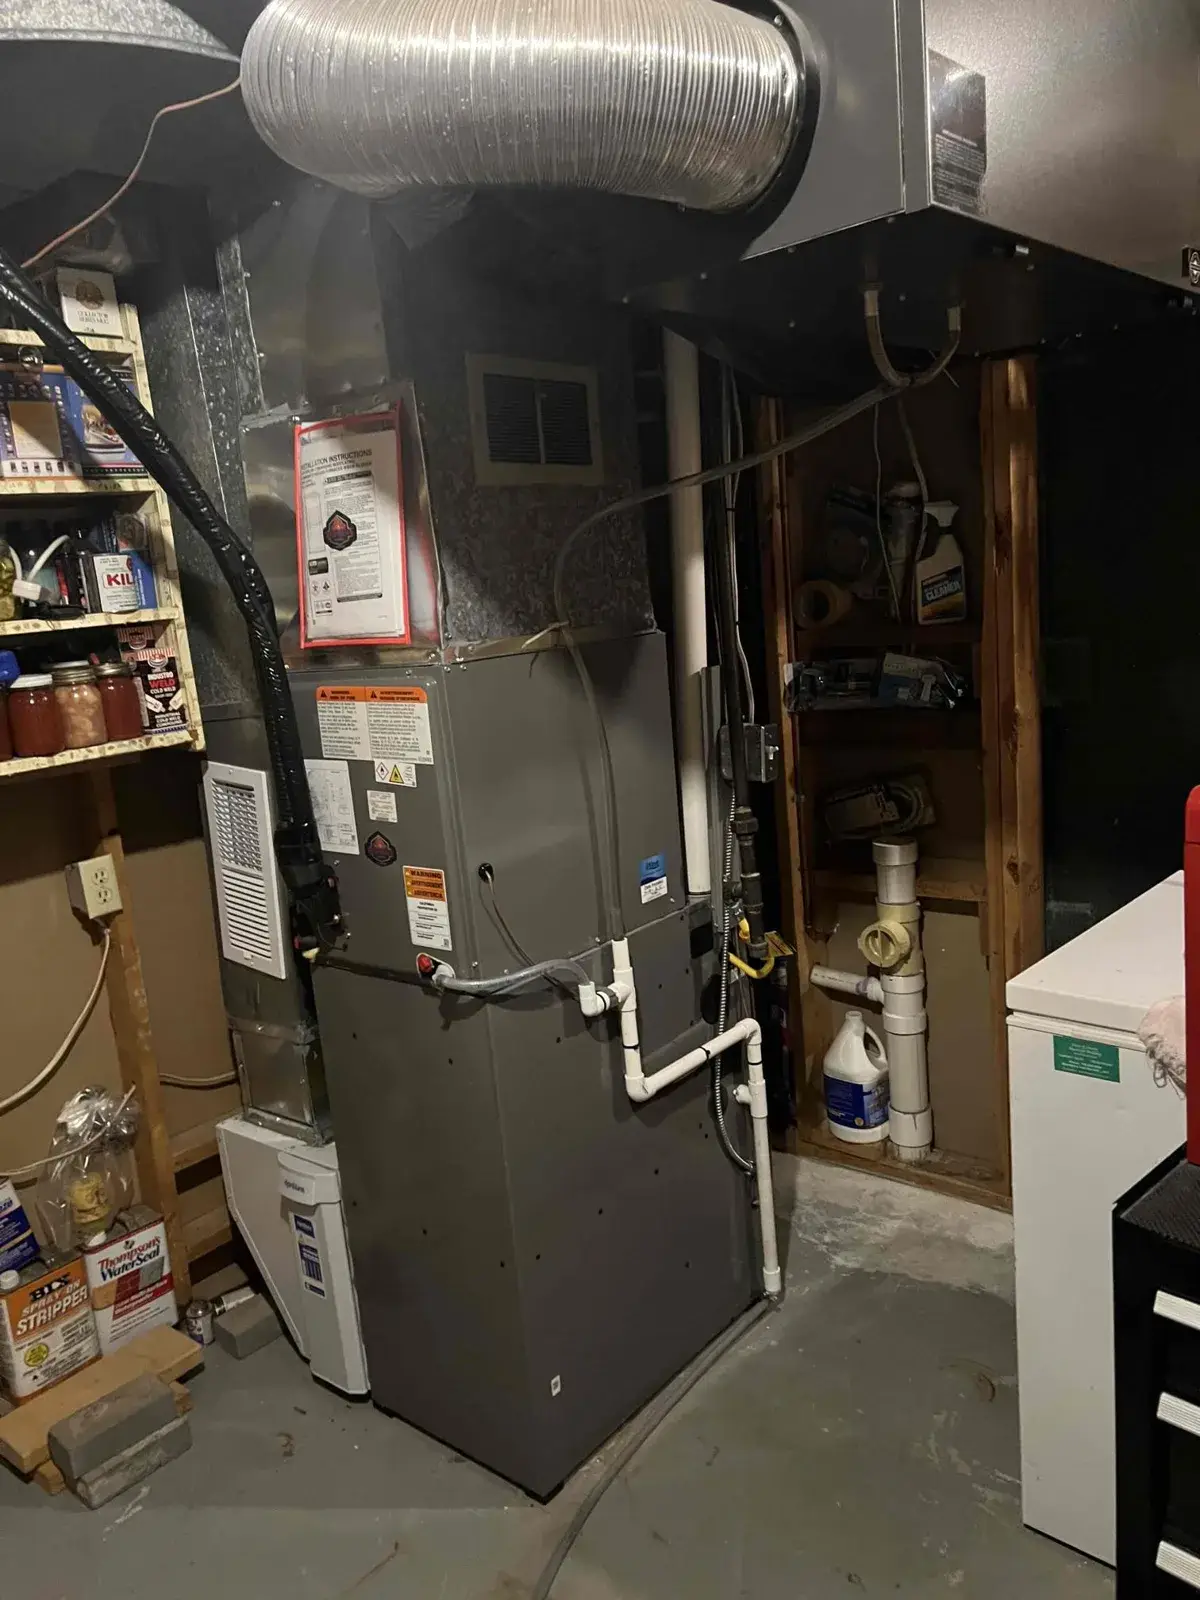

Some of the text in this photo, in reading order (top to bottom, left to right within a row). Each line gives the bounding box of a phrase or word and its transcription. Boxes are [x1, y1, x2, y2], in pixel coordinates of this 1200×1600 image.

[328, 448, 373, 462] INSTRUCTIONS
[149, 679, 176, 688] WELD
[100, 1245, 160, 1281] WaterSeal
[16, 1286, 89, 1336] STRIPPER
[22, 1279, 81, 1317] SPRAY ON
